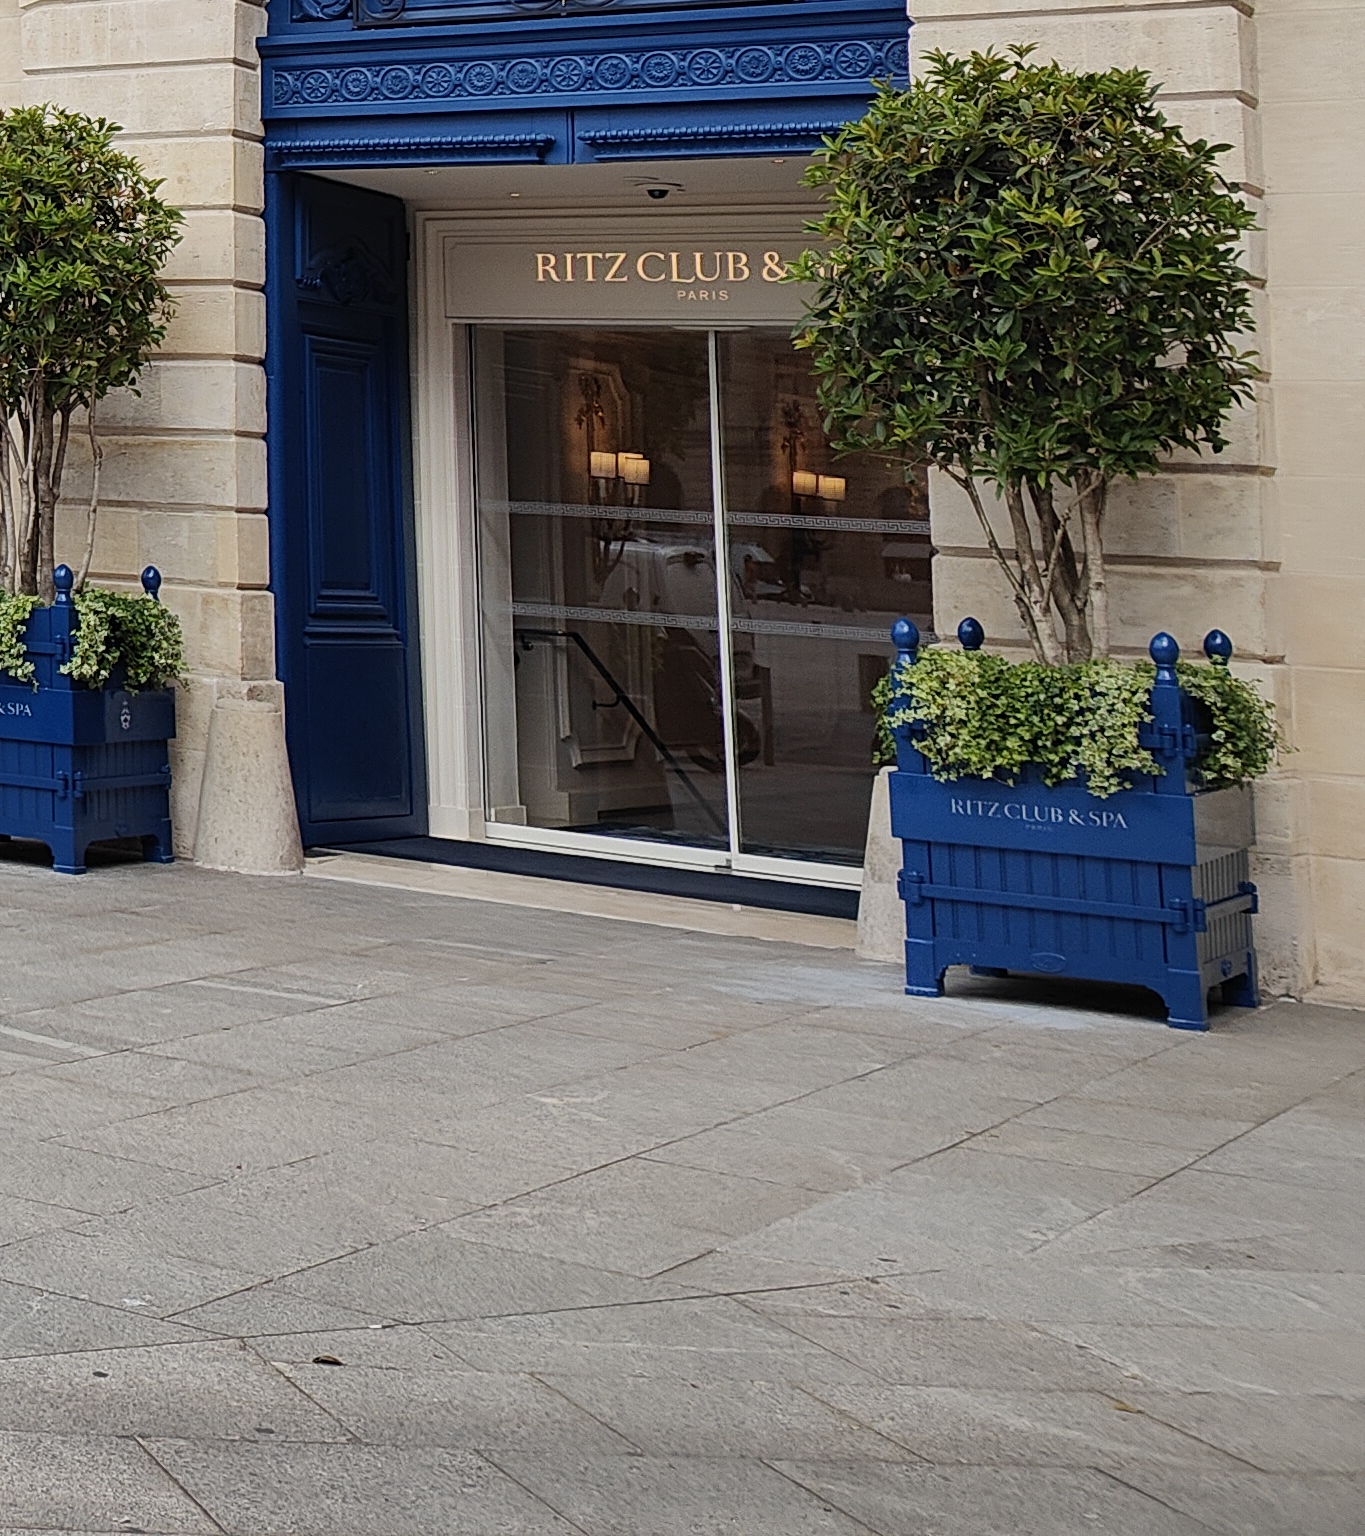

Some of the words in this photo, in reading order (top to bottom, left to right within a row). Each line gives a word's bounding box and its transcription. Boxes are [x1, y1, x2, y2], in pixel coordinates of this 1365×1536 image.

[535, 252, 628, 282] RITZ
[637, 251, 750, 284] CLUB
[762, 251, 788, 283] &
[677, 290, 729, 301] PARIS
[7, 702, 32, 716] SPA
[951, 798, 1001, 818] RITZ
[1004, 803, 1064, 822] CLUB
[1068, 808, 1086, 826] &
[1088, 810, 1129, 829] SPA
